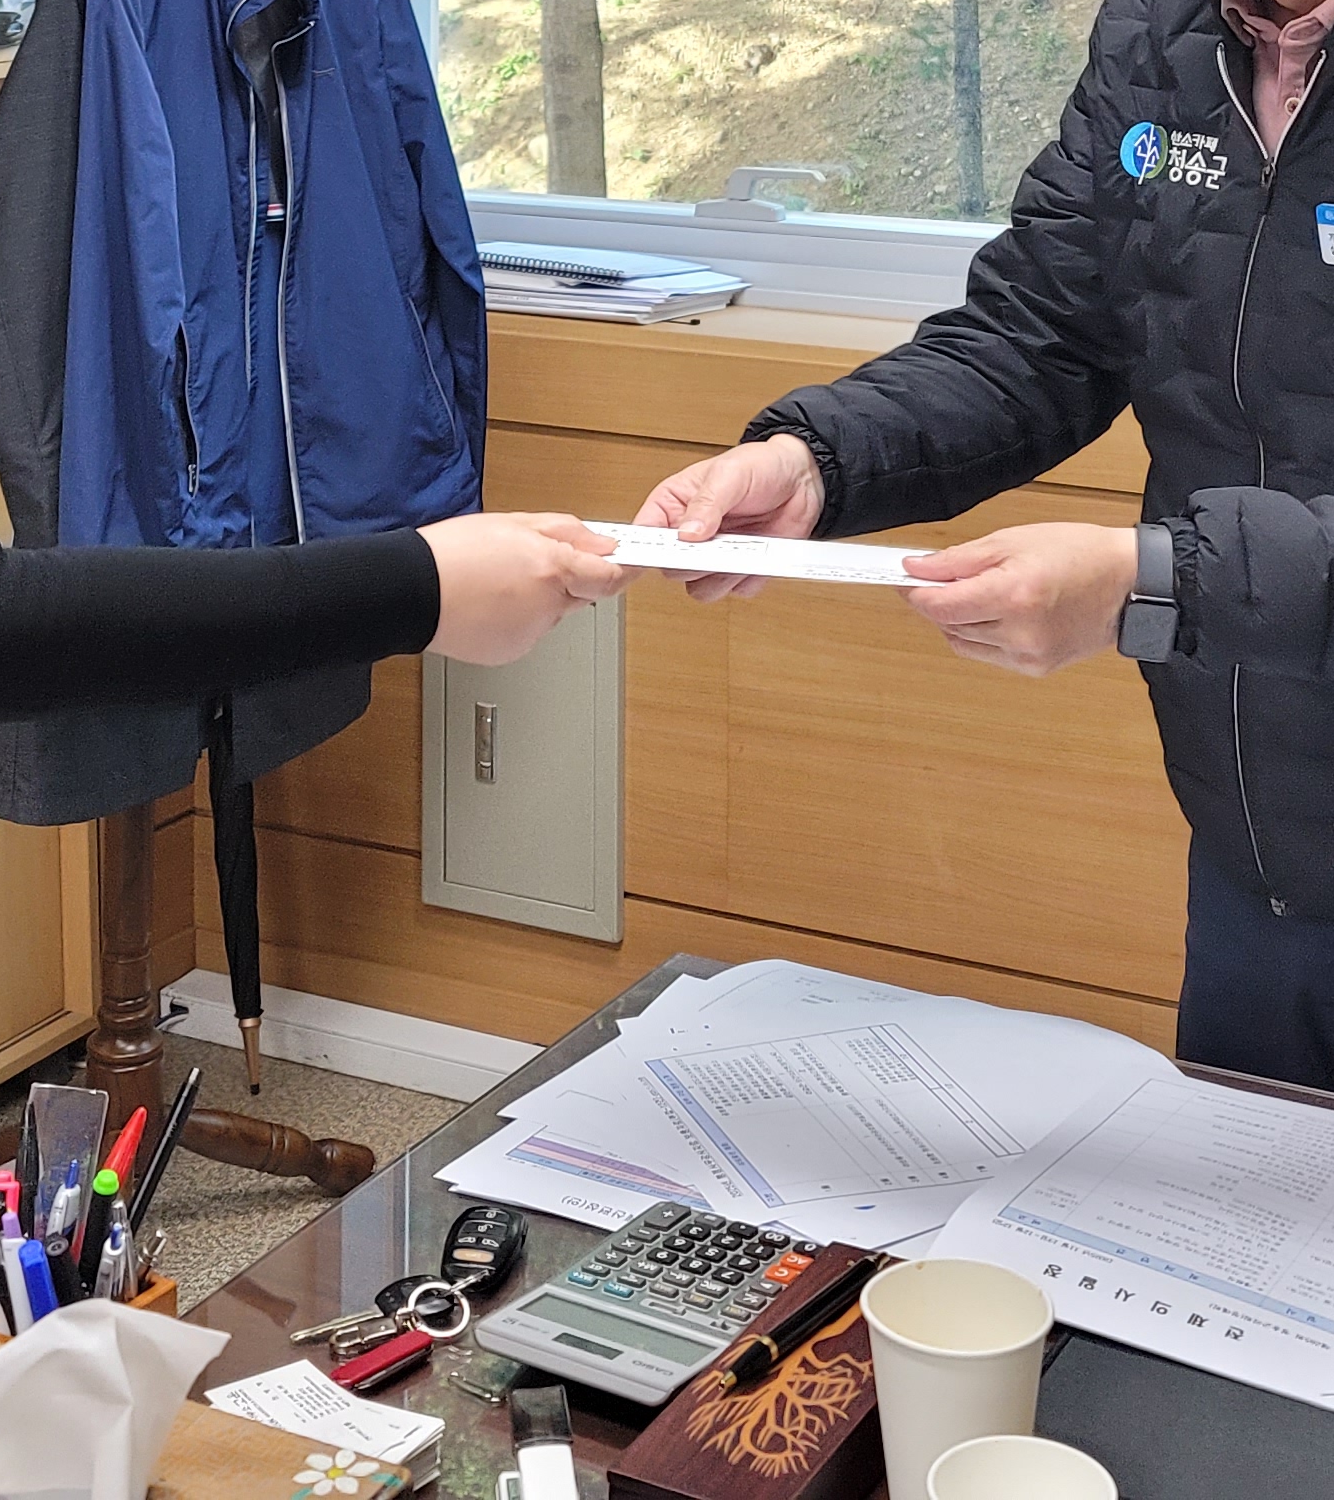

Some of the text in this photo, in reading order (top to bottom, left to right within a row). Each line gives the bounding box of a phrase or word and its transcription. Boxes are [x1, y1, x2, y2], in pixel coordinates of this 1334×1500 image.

[1170, 130, 1219, 153] 산소카페
[1167, 146, 1228, 190] 청송군
[673, 1237, 752, 1266] 4 5 6
[689, 1226, 765, 1254] 1 2 3
[765, 1231, 817, 1252] 0 00
[655, 1251, 735, 1280] 7 8 9
[786, 1255, 808, 1265] AC
[774, 1268, 789, 1277] C
[631, 1358, 675, 1377] CASIO
